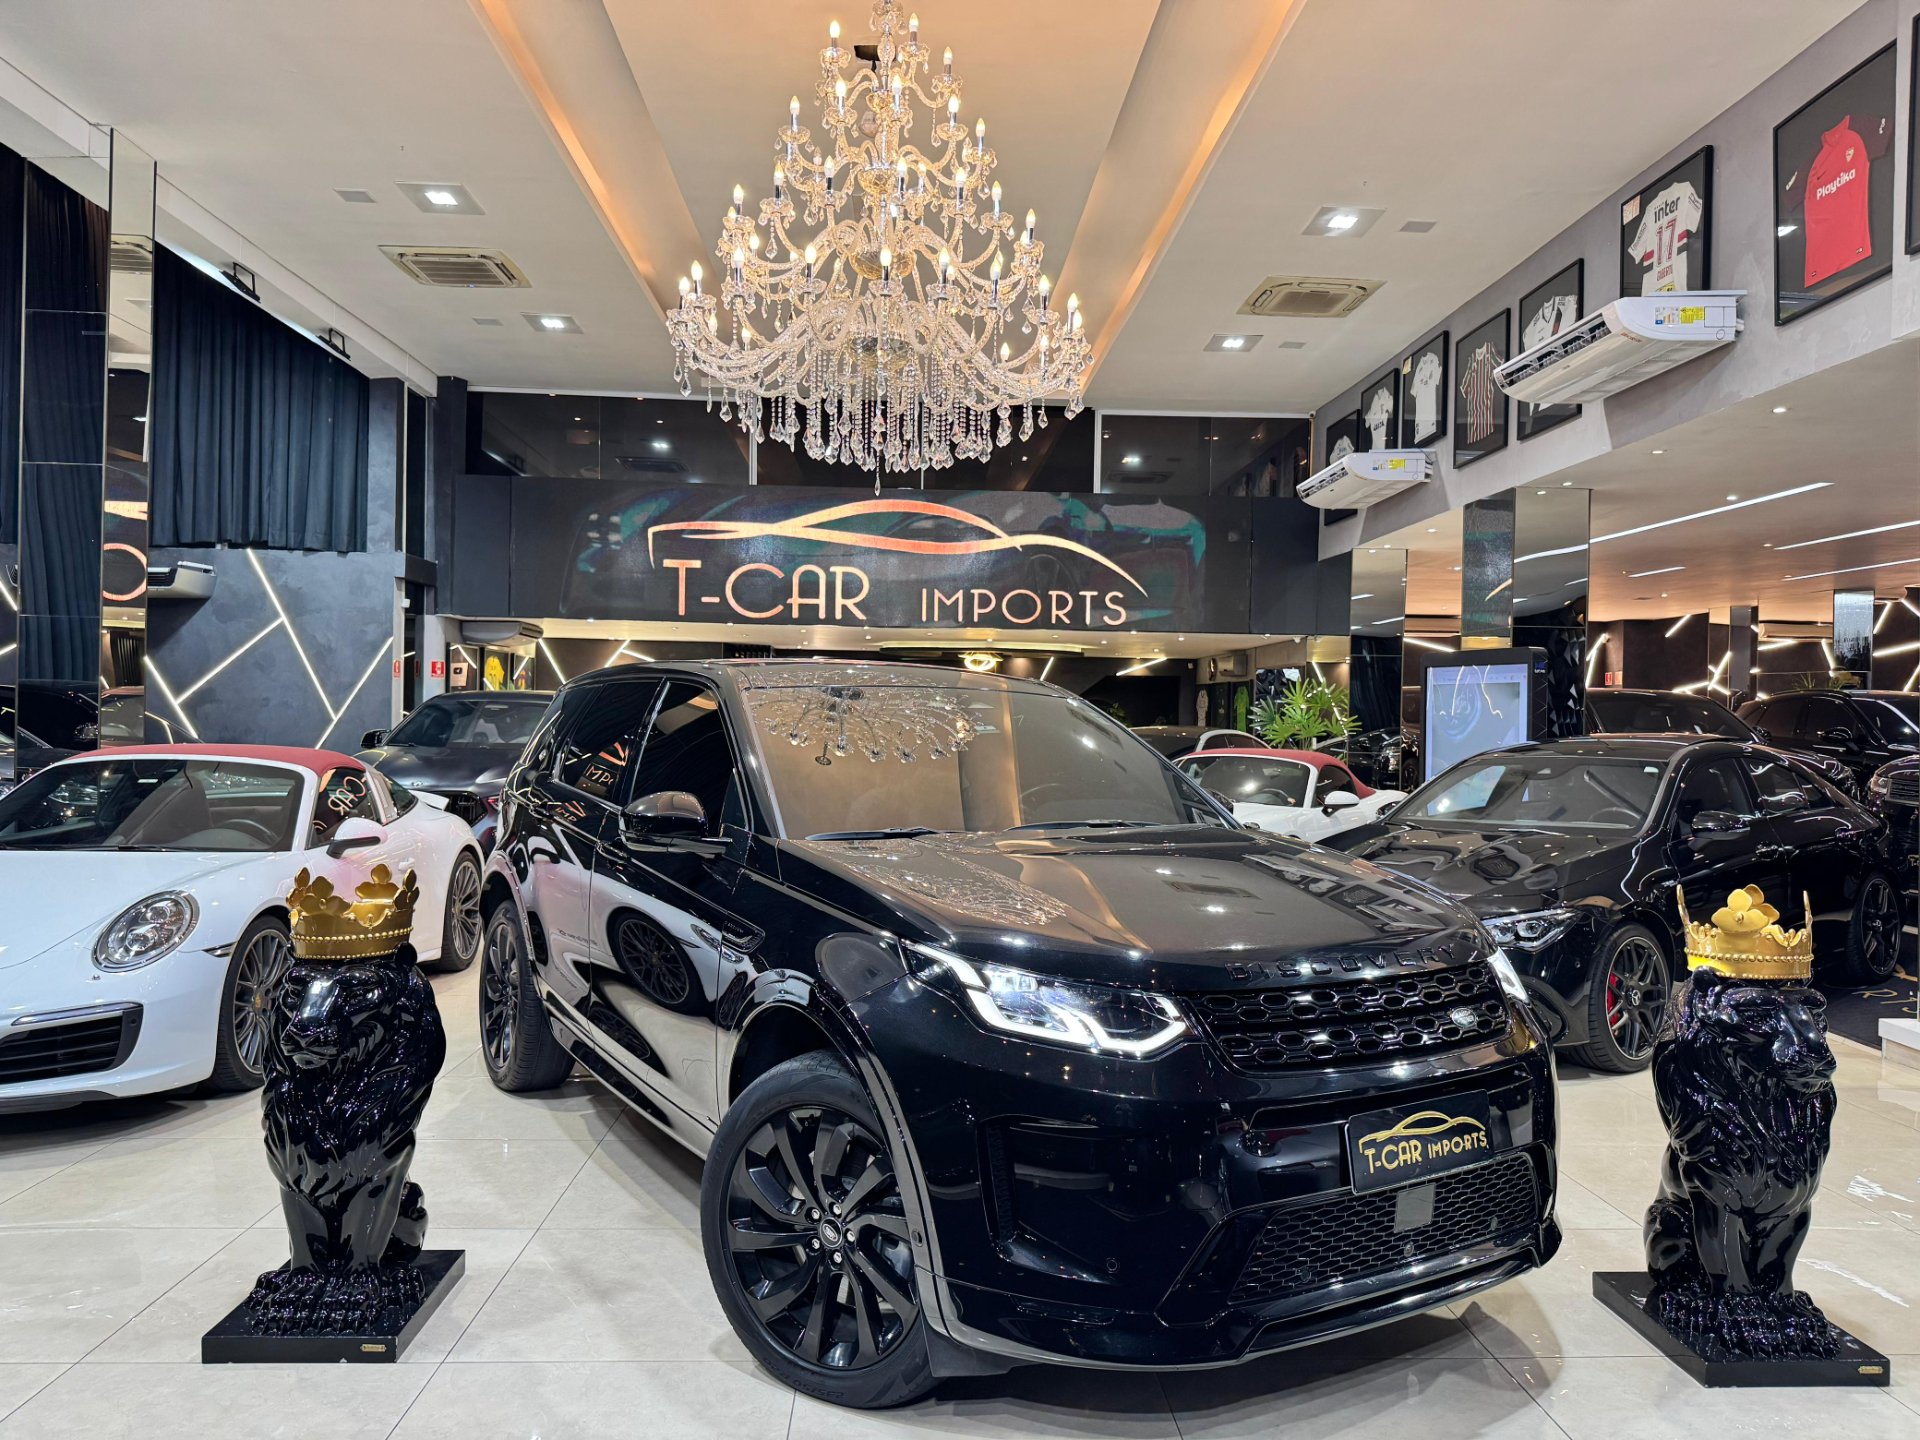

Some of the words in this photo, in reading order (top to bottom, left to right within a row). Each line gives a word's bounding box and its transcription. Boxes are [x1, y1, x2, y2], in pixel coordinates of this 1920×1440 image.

[1816, 168, 1856, 200] Playtika
[1654, 196, 1681, 224] inter
[1655, 217, 1677, 266] 17
[662, 558, 871, 621] T-CAR
[920, 587, 1128, 627] IMPORTS
[1224, 943, 1456, 982] DISCOVERY
[1364, 1139, 1422, 1174] T-CAR
[1427, 1130, 1488, 1160] IMPORTS
